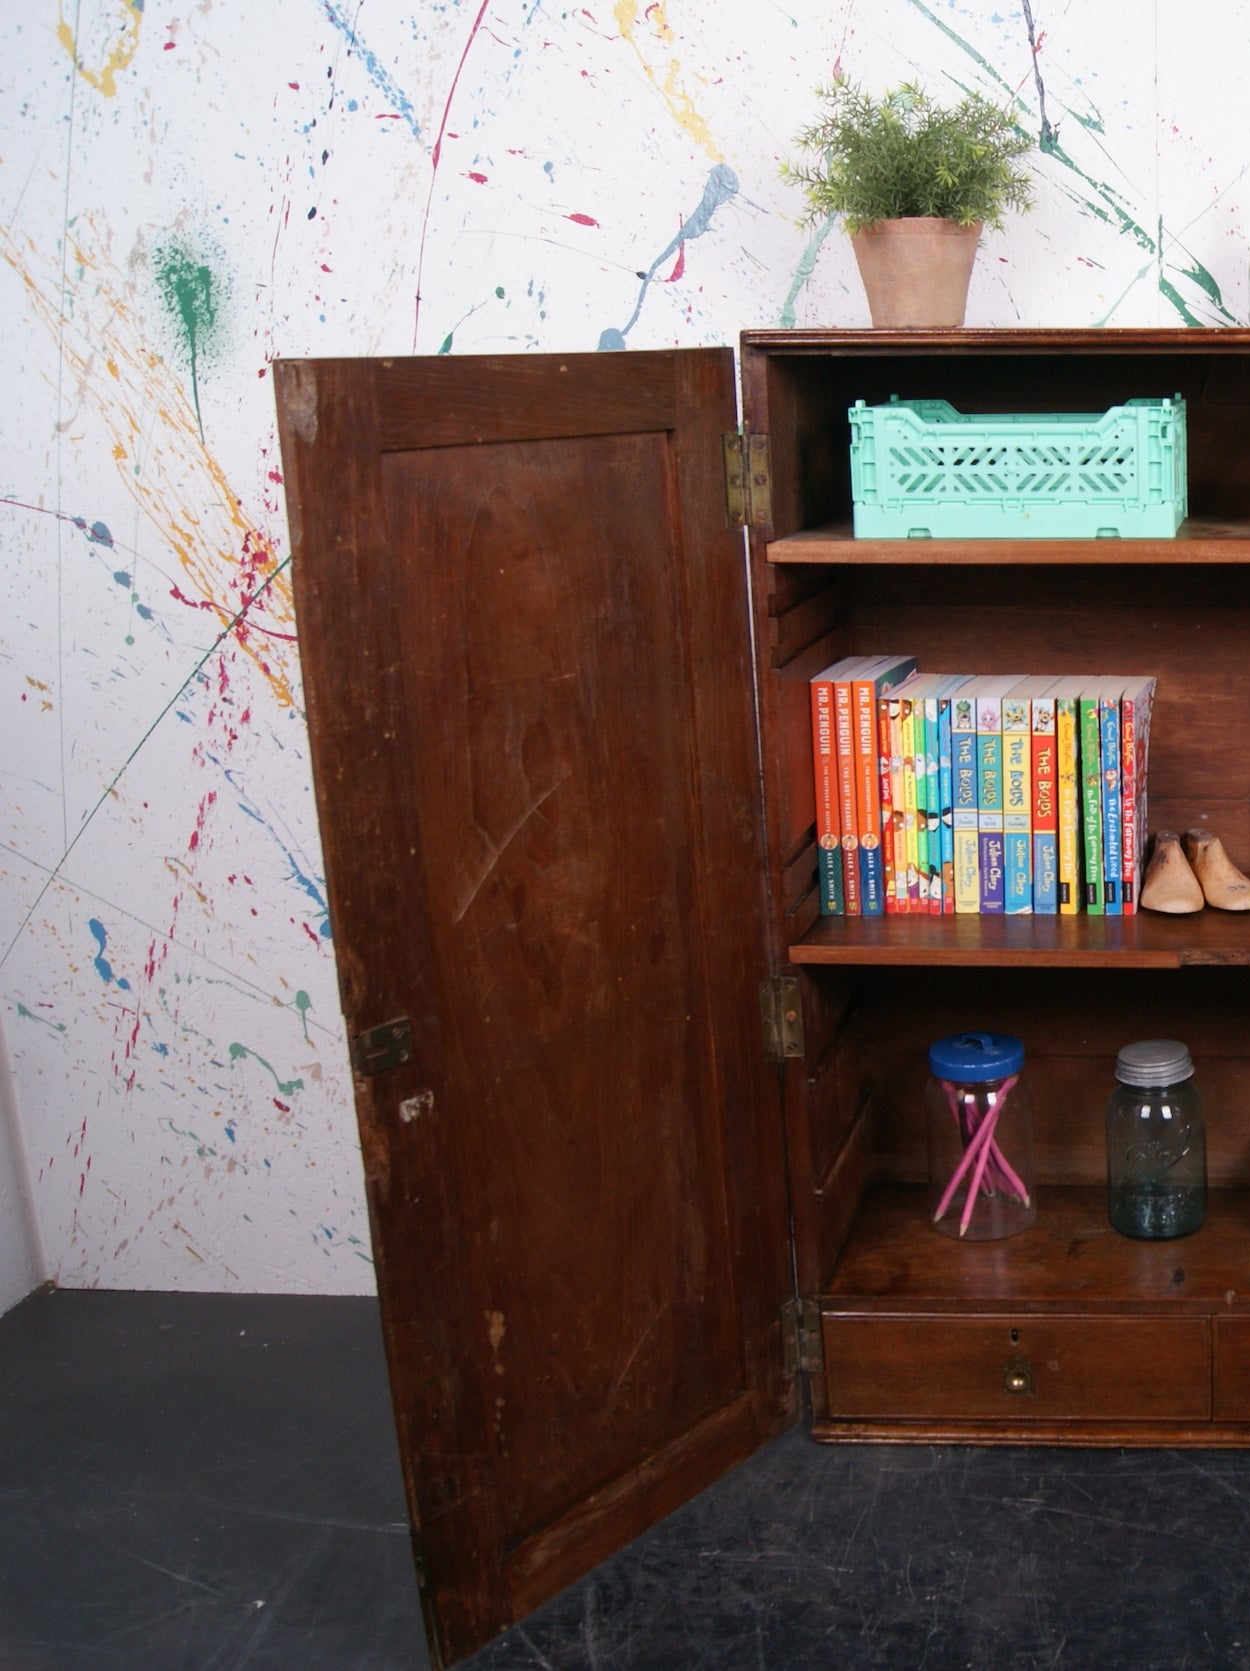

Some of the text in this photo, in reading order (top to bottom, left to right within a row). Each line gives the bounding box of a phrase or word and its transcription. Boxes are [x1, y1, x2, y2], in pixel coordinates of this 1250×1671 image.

[818, 688, 830, 755] MR. PENGUIN
[837, 689, 850, 756] MR. PENGUIN
[859, 688, 872, 755] MR. PENGUIN
[959, 737, 972, 763] THE
[982, 739, 996, 764] THE
[1010, 738, 1024, 765] THE
[958, 770, 973, 804] BOLDS
[982, 770, 997, 806] BOLDS
[1009, 771, 1024, 807] BOLDS
[1037, 748, 1052, 818] THE BOLDS
[1124, 798, 1133, 807] Up
[1107, 813, 1118, 855] Enchanted
[1124, 823, 1133, 859] Faraway
[988, 841, 1001, 867] Julian
[1042, 846, 1055, 871] Julian
[1087, 836, 1097, 865] Faraway
[964, 866, 976, 888] Clary
[988, 868, 1001, 890] Clary
[1016, 840, 1026, 896] Julian Clary
[1110, 857, 1118, 878] Wood
[1125, 862, 1133, 877] Tree
[1042, 872, 1054, 893] Clary
